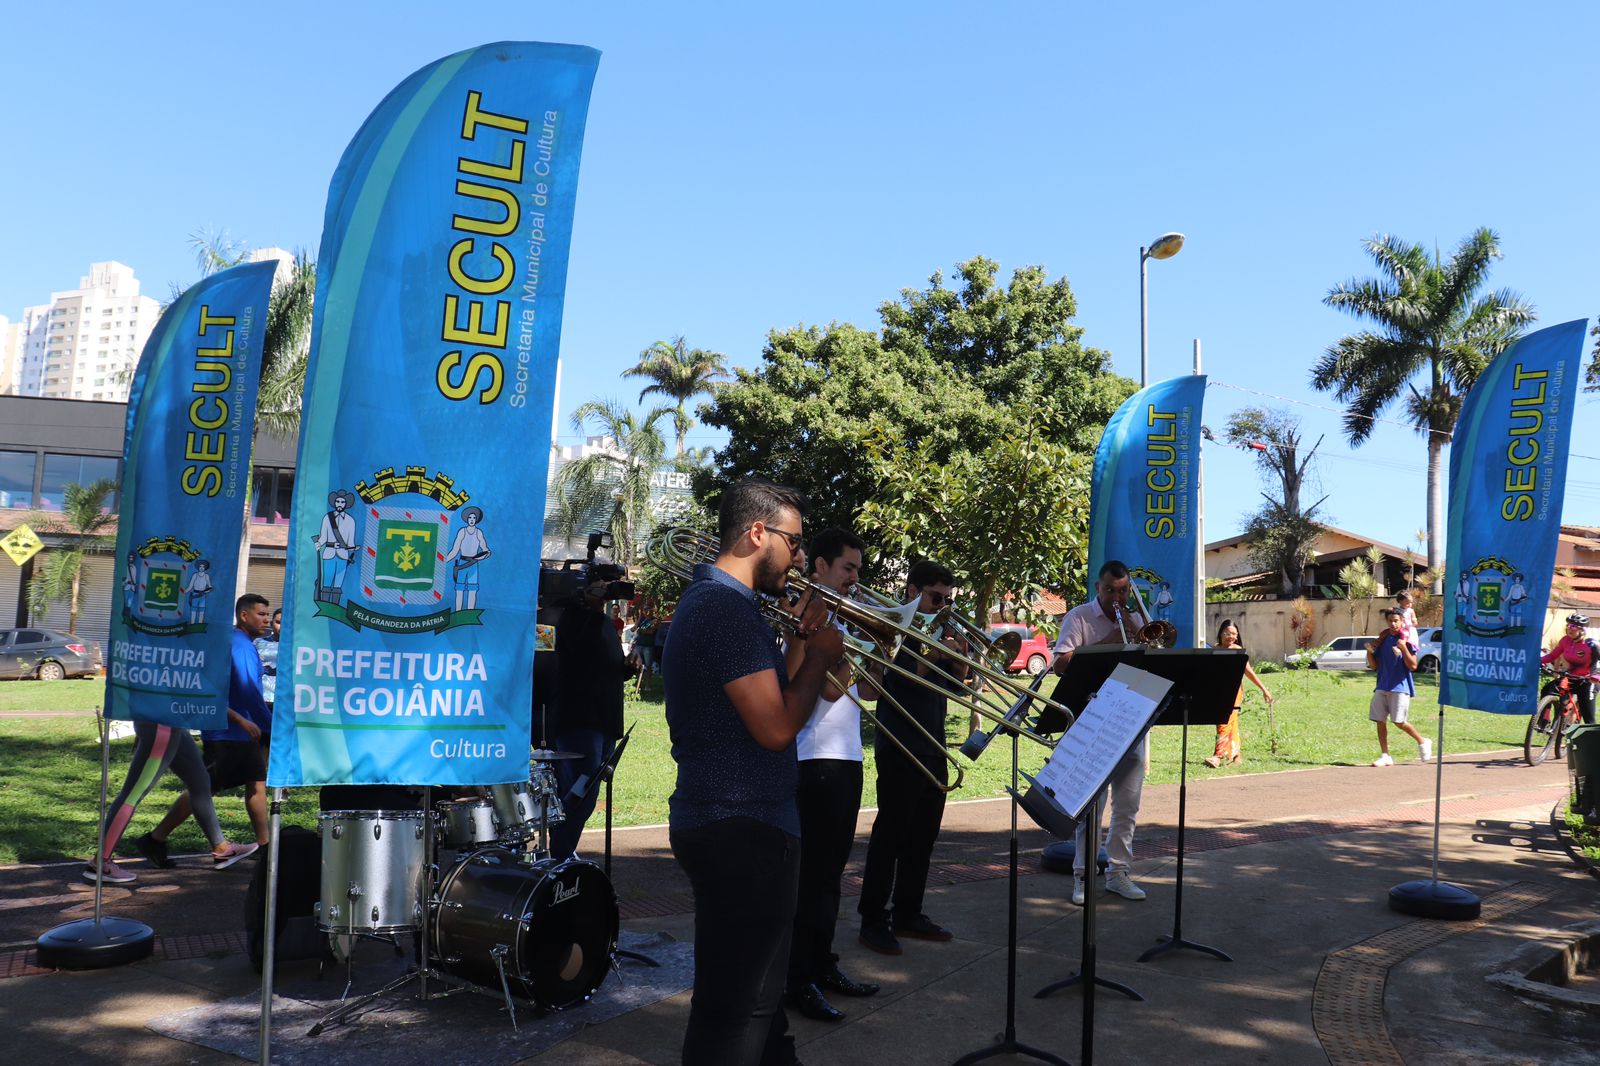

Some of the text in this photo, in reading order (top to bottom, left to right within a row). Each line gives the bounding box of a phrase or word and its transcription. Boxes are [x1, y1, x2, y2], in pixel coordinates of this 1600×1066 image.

[436, 90, 529, 405] SECULT
[511, 110, 557, 408] Secretaria Municipal de Cultura
[181, 305, 236, 496] SECULT
[226, 306, 253, 499] Secretaria Municipal de Cultura
[1502, 363, 1548, 521] SECULT
[1544, 412, 1558, 464] Municipal
[1145, 404, 1176, 539] SECULT
[352, 610, 369, 622] PELA
[370, 617, 408, 628] GRANDEZA
[113, 640, 205, 668] PREFEITURA
[295, 646, 488, 681] PREFEITURA
[1449, 642, 1526, 664] PREFEITURA
[112, 662, 203, 690] DE GOIÂNIA
[1447, 659, 1524, 681] DE GOIÂNIA
[170, 701, 216, 716] Cultura
[294, 683, 485, 717] DE GOIÂNIA
[1499, 691, 1528, 703] Cultura
[430, 738, 506, 759] Cultura
[549, 876, 580, 907] Pearl
